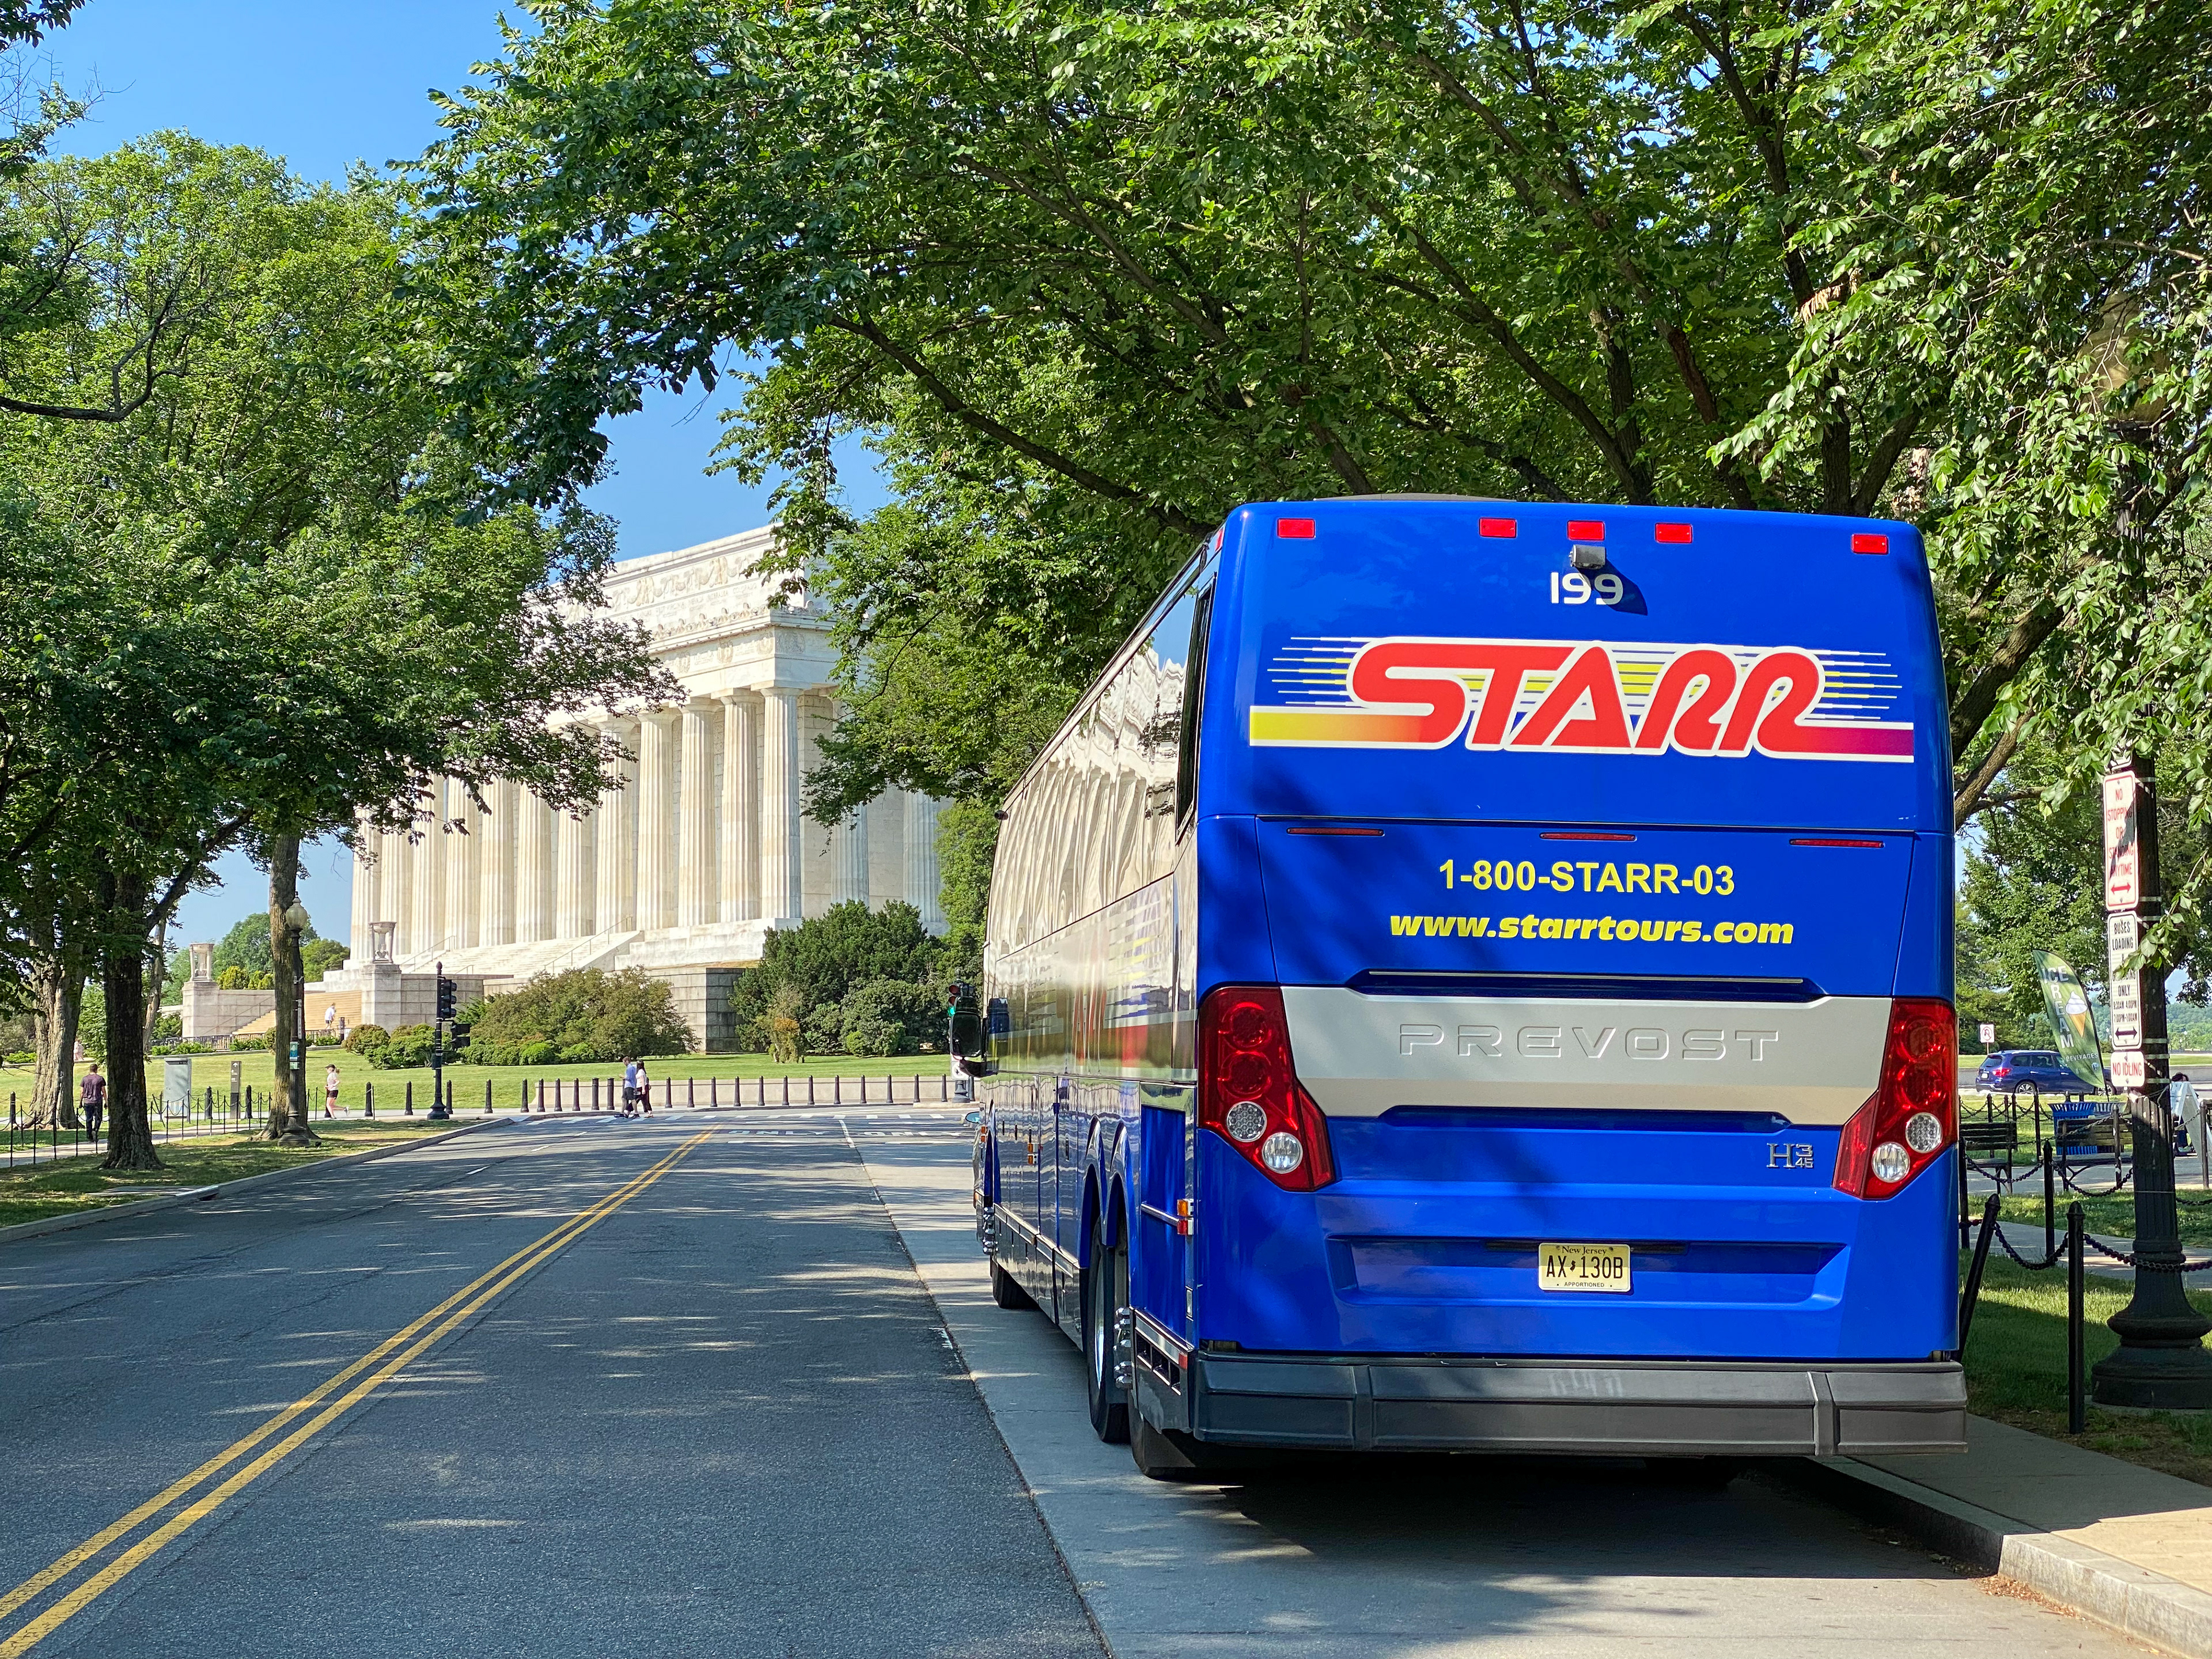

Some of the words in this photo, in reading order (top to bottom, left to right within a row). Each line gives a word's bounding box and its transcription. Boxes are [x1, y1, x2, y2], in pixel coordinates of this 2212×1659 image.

[1551, 572, 1624, 606] 199
[1346, 637, 1827, 760] STARR
[2115, 788, 2123, 801] NO
[2107, 806, 2133, 822] STOPPING
[2115, 826, 2124, 839] OR
[2109, 843, 2134, 859] STANDING
[1439, 859, 1735, 896] 1-800-STARR-03
[1390, 914, 1794, 944] www.starrtours.com
[2113, 921, 2130, 934] BUSES
[2112, 937, 2134, 950] LOADING
[2041, 965, 2069, 984] ICE
[2118, 984, 2130, 997] ONLY
[1399, 1023, 1779, 1062] PREVOST
[2066, 1052, 2099, 1062] BEVERAGES
[2112, 1062, 2121, 1076] NO
[2122, 1062, 2142, 1076] IDLING
[1562, 1245, 1581, 1254] New
[1582, 1245, 1607, 1256] Jersey
[1546, 1255, 1567, 1278] AX
[1579, 1256, 1623, 1279] 130B
